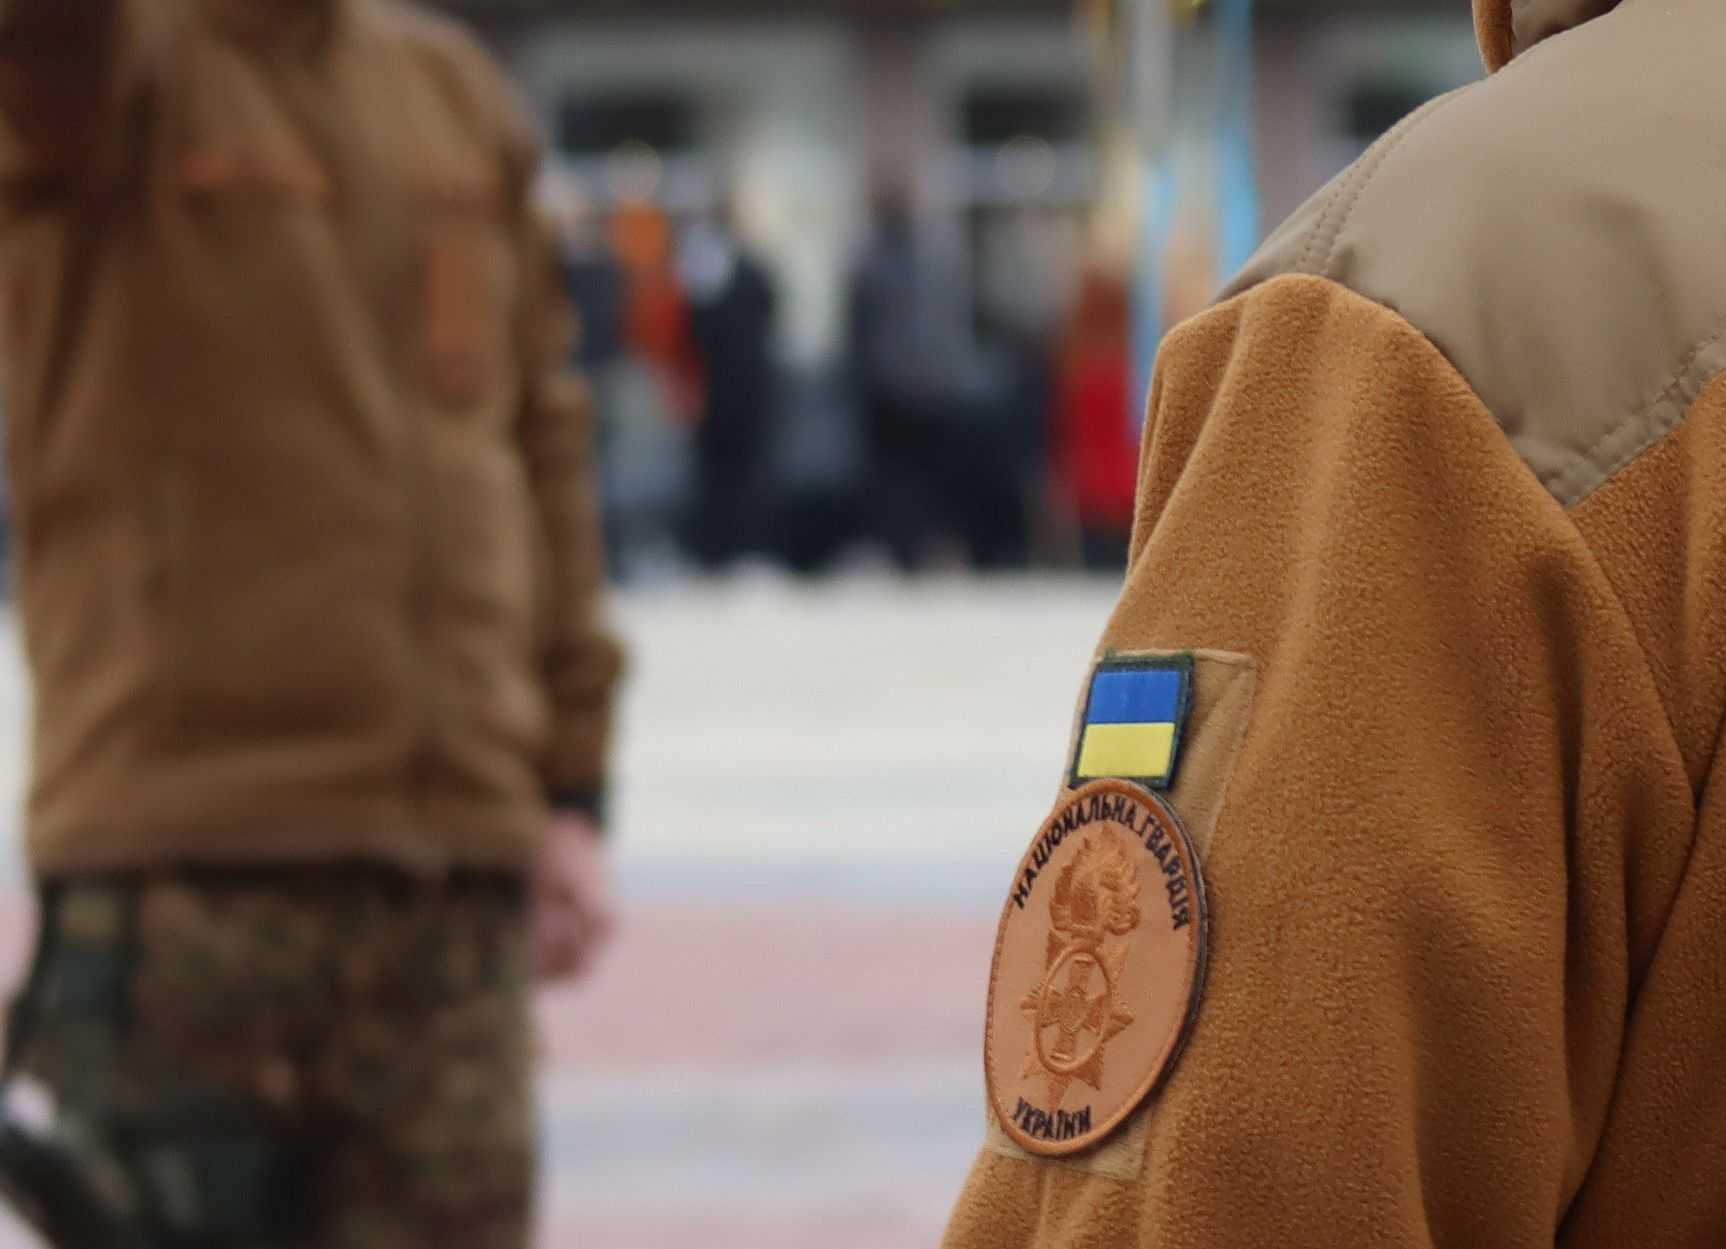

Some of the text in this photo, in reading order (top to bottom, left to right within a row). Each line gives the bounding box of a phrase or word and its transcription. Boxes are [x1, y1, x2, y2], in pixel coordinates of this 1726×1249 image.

[1012, 794, 1190, 930] НАЦІОНАЛЬНА ГВАРДІЯ
[1013, 1096, 1091, 1140] УКРАЇНИ
